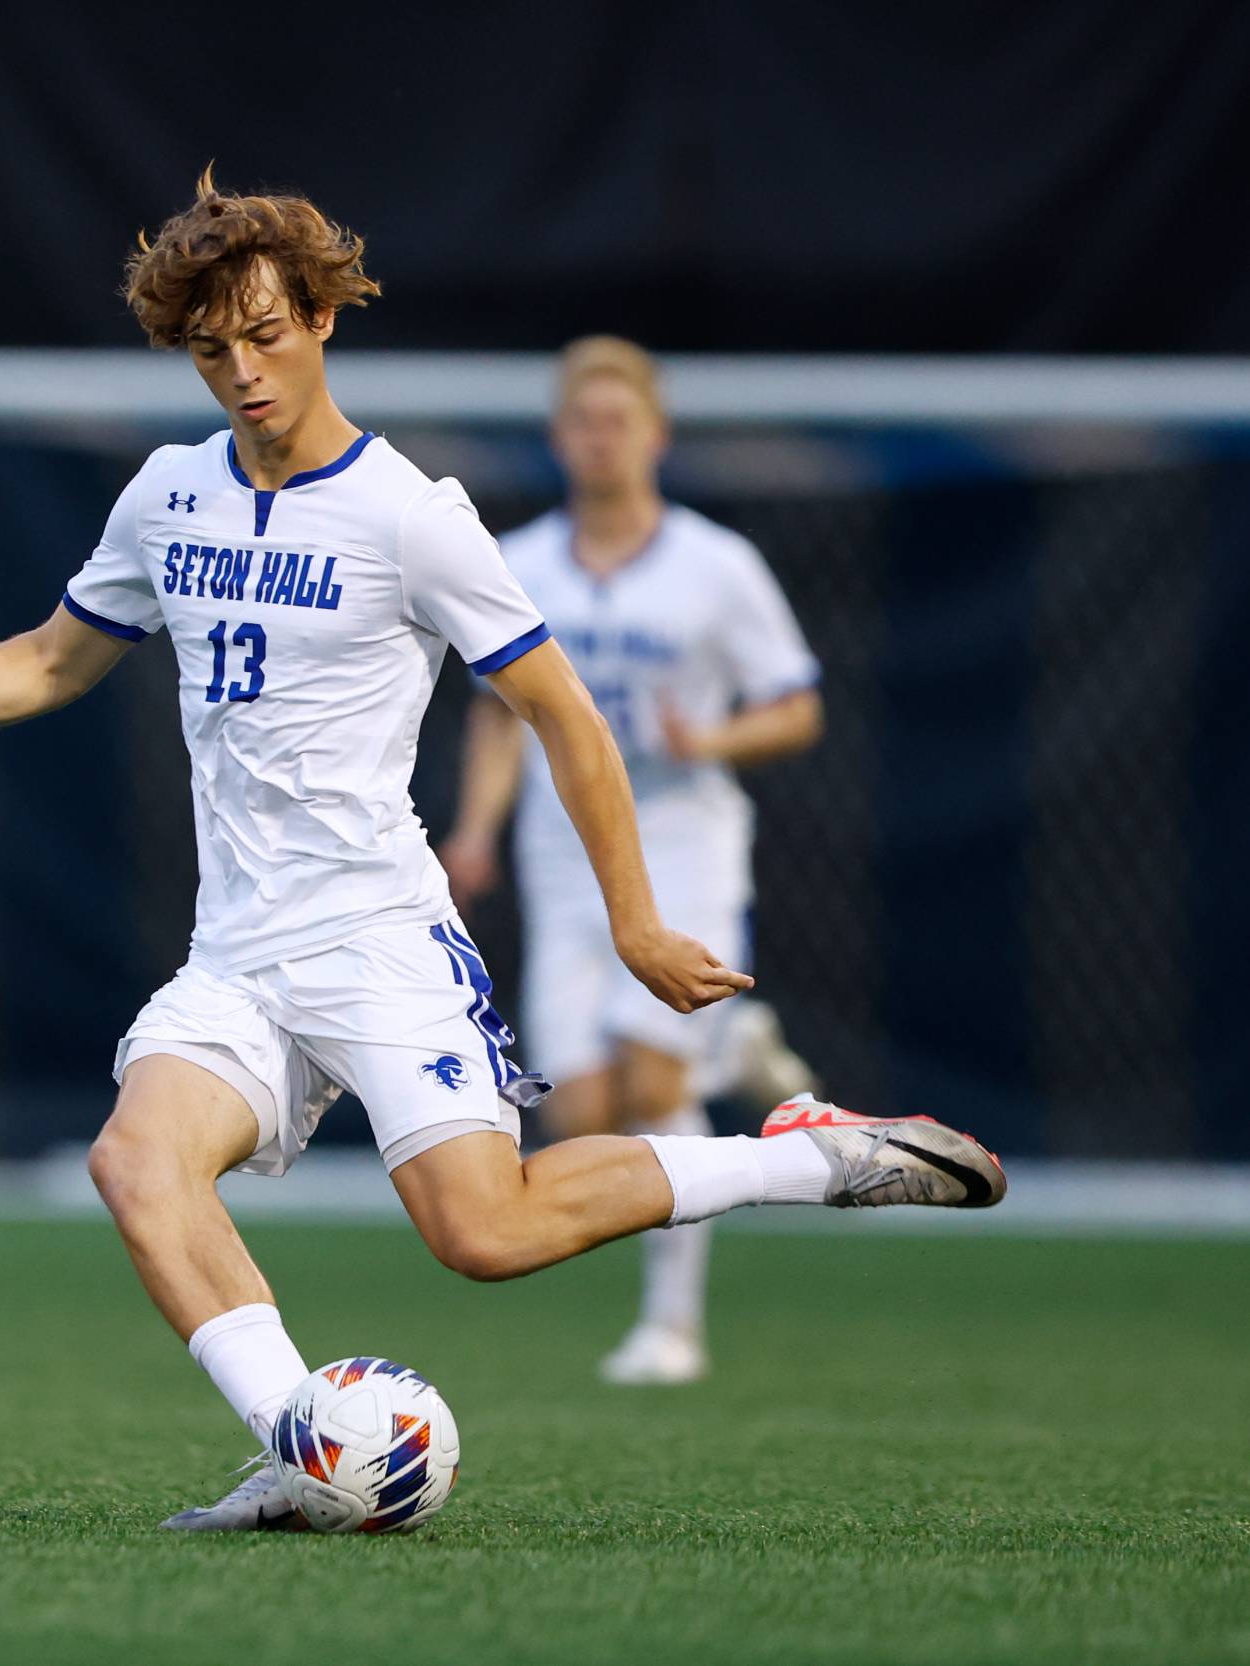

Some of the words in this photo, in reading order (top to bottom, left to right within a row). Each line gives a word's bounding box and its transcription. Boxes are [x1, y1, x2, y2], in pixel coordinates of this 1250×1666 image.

[163, 542, 254, 602] SETON
[254, 551, 343, 611] HALL
[205, 620, 267, 704] 13
